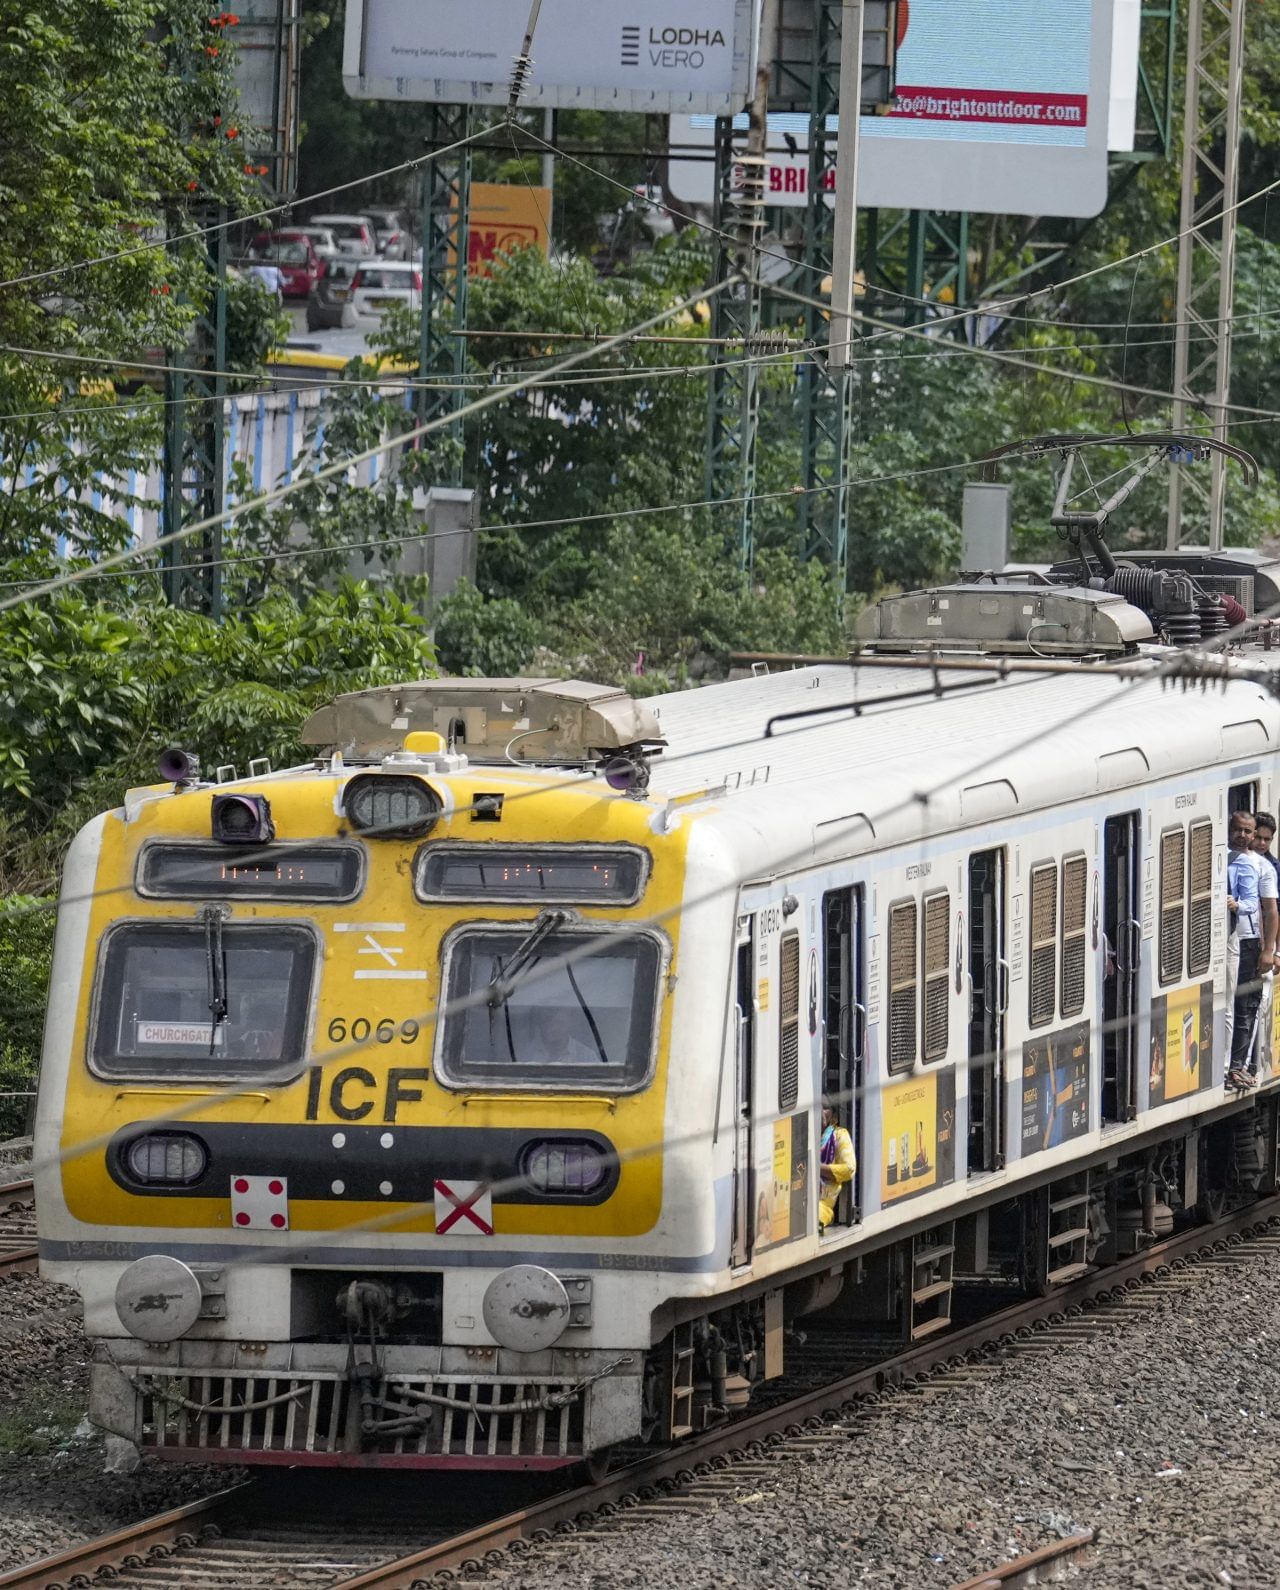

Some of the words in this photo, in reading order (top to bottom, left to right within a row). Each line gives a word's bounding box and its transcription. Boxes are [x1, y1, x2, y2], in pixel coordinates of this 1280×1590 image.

[649, 27, 725, 47] LODHA
[650, 50, 705, 69] VERO
[328, 1017, 420, 1044] 6069
[306, 1066, 429, 1122] ICF
